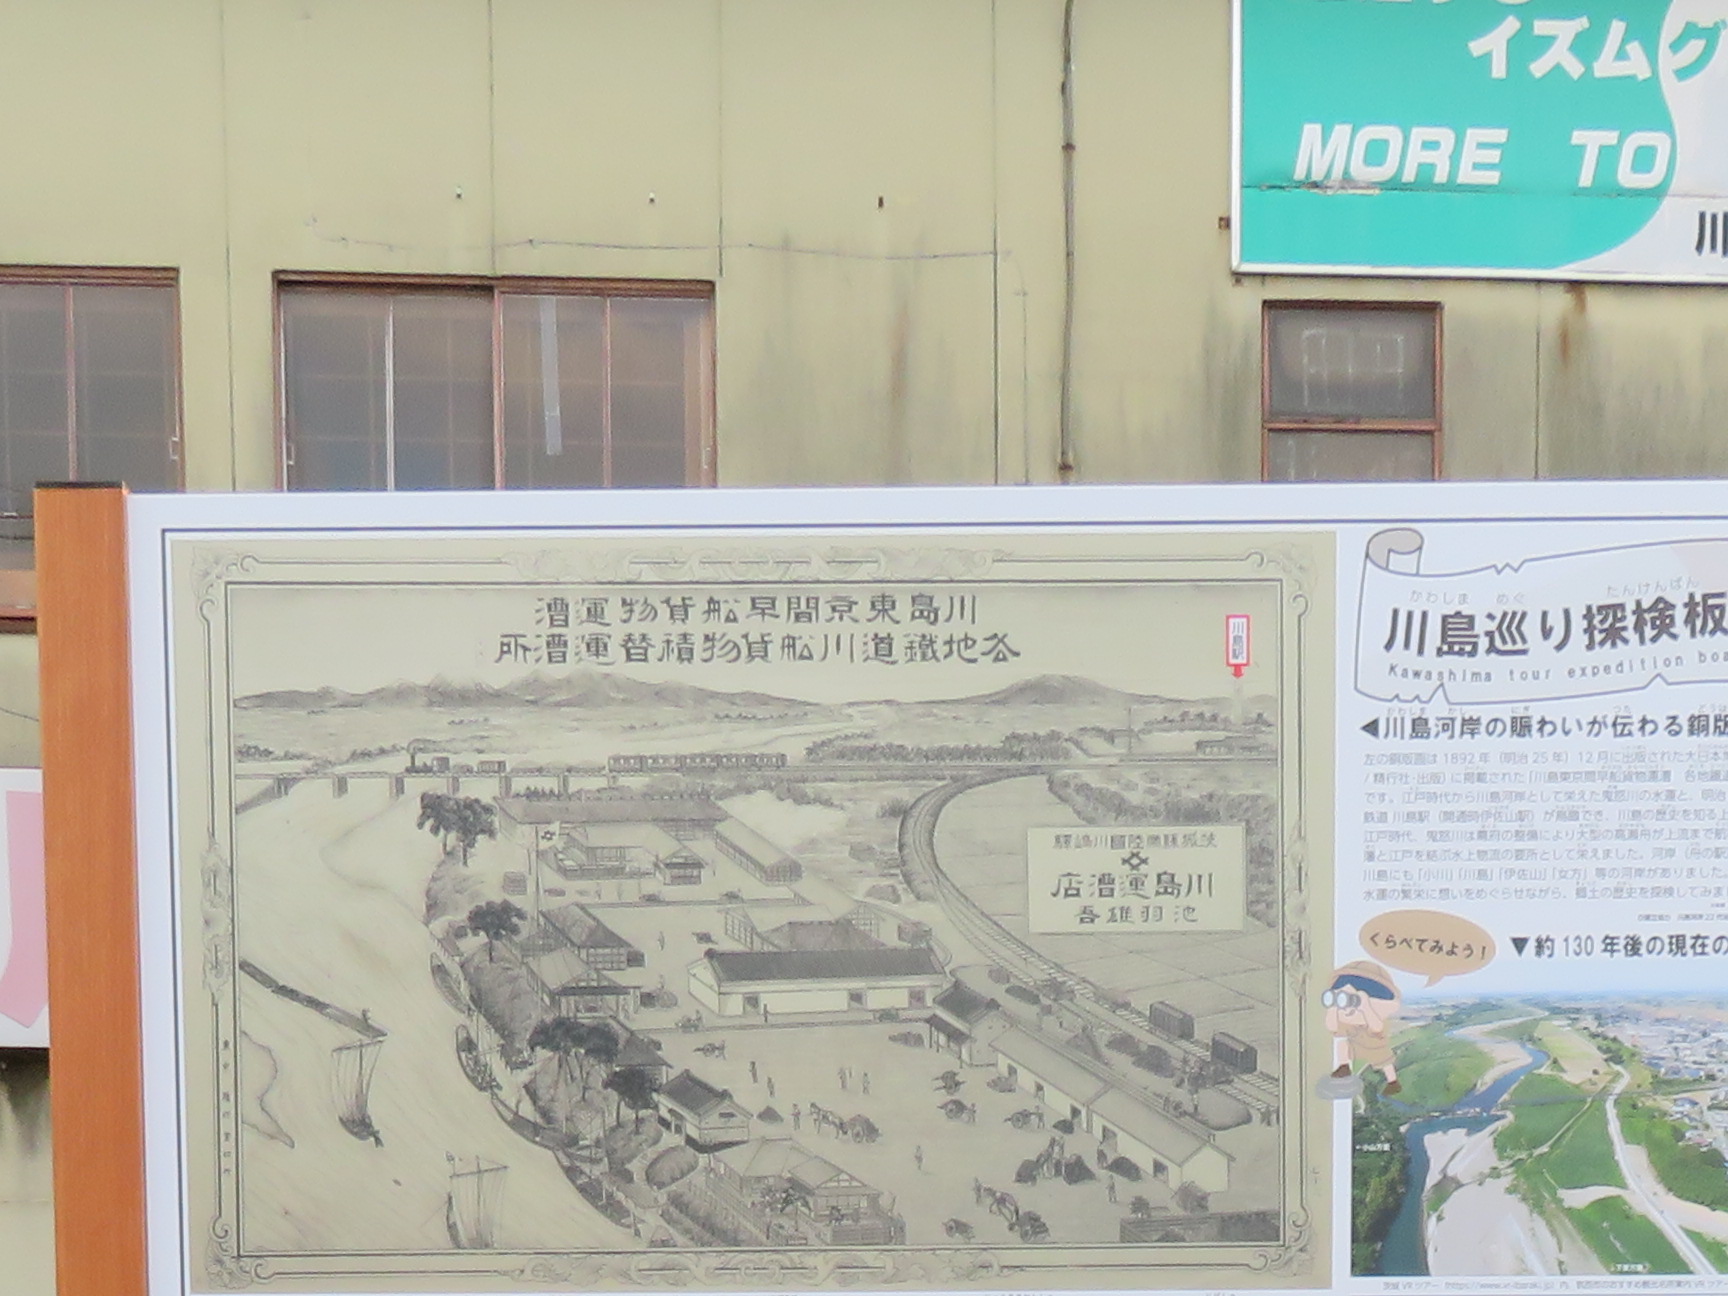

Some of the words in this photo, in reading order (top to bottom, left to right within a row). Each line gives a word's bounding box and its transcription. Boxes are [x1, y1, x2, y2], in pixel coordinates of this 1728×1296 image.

[1294, 122, 1509, 187] MORE
[1571, 128, 1672, 190] TO
[1389, 662, 1493, 683] Kawashima
[1509, 667, 1552, 682] tour
[1568, 653, 1684, 681] expedition
[1368, 931, 1488, 961] くらべてみよう！
